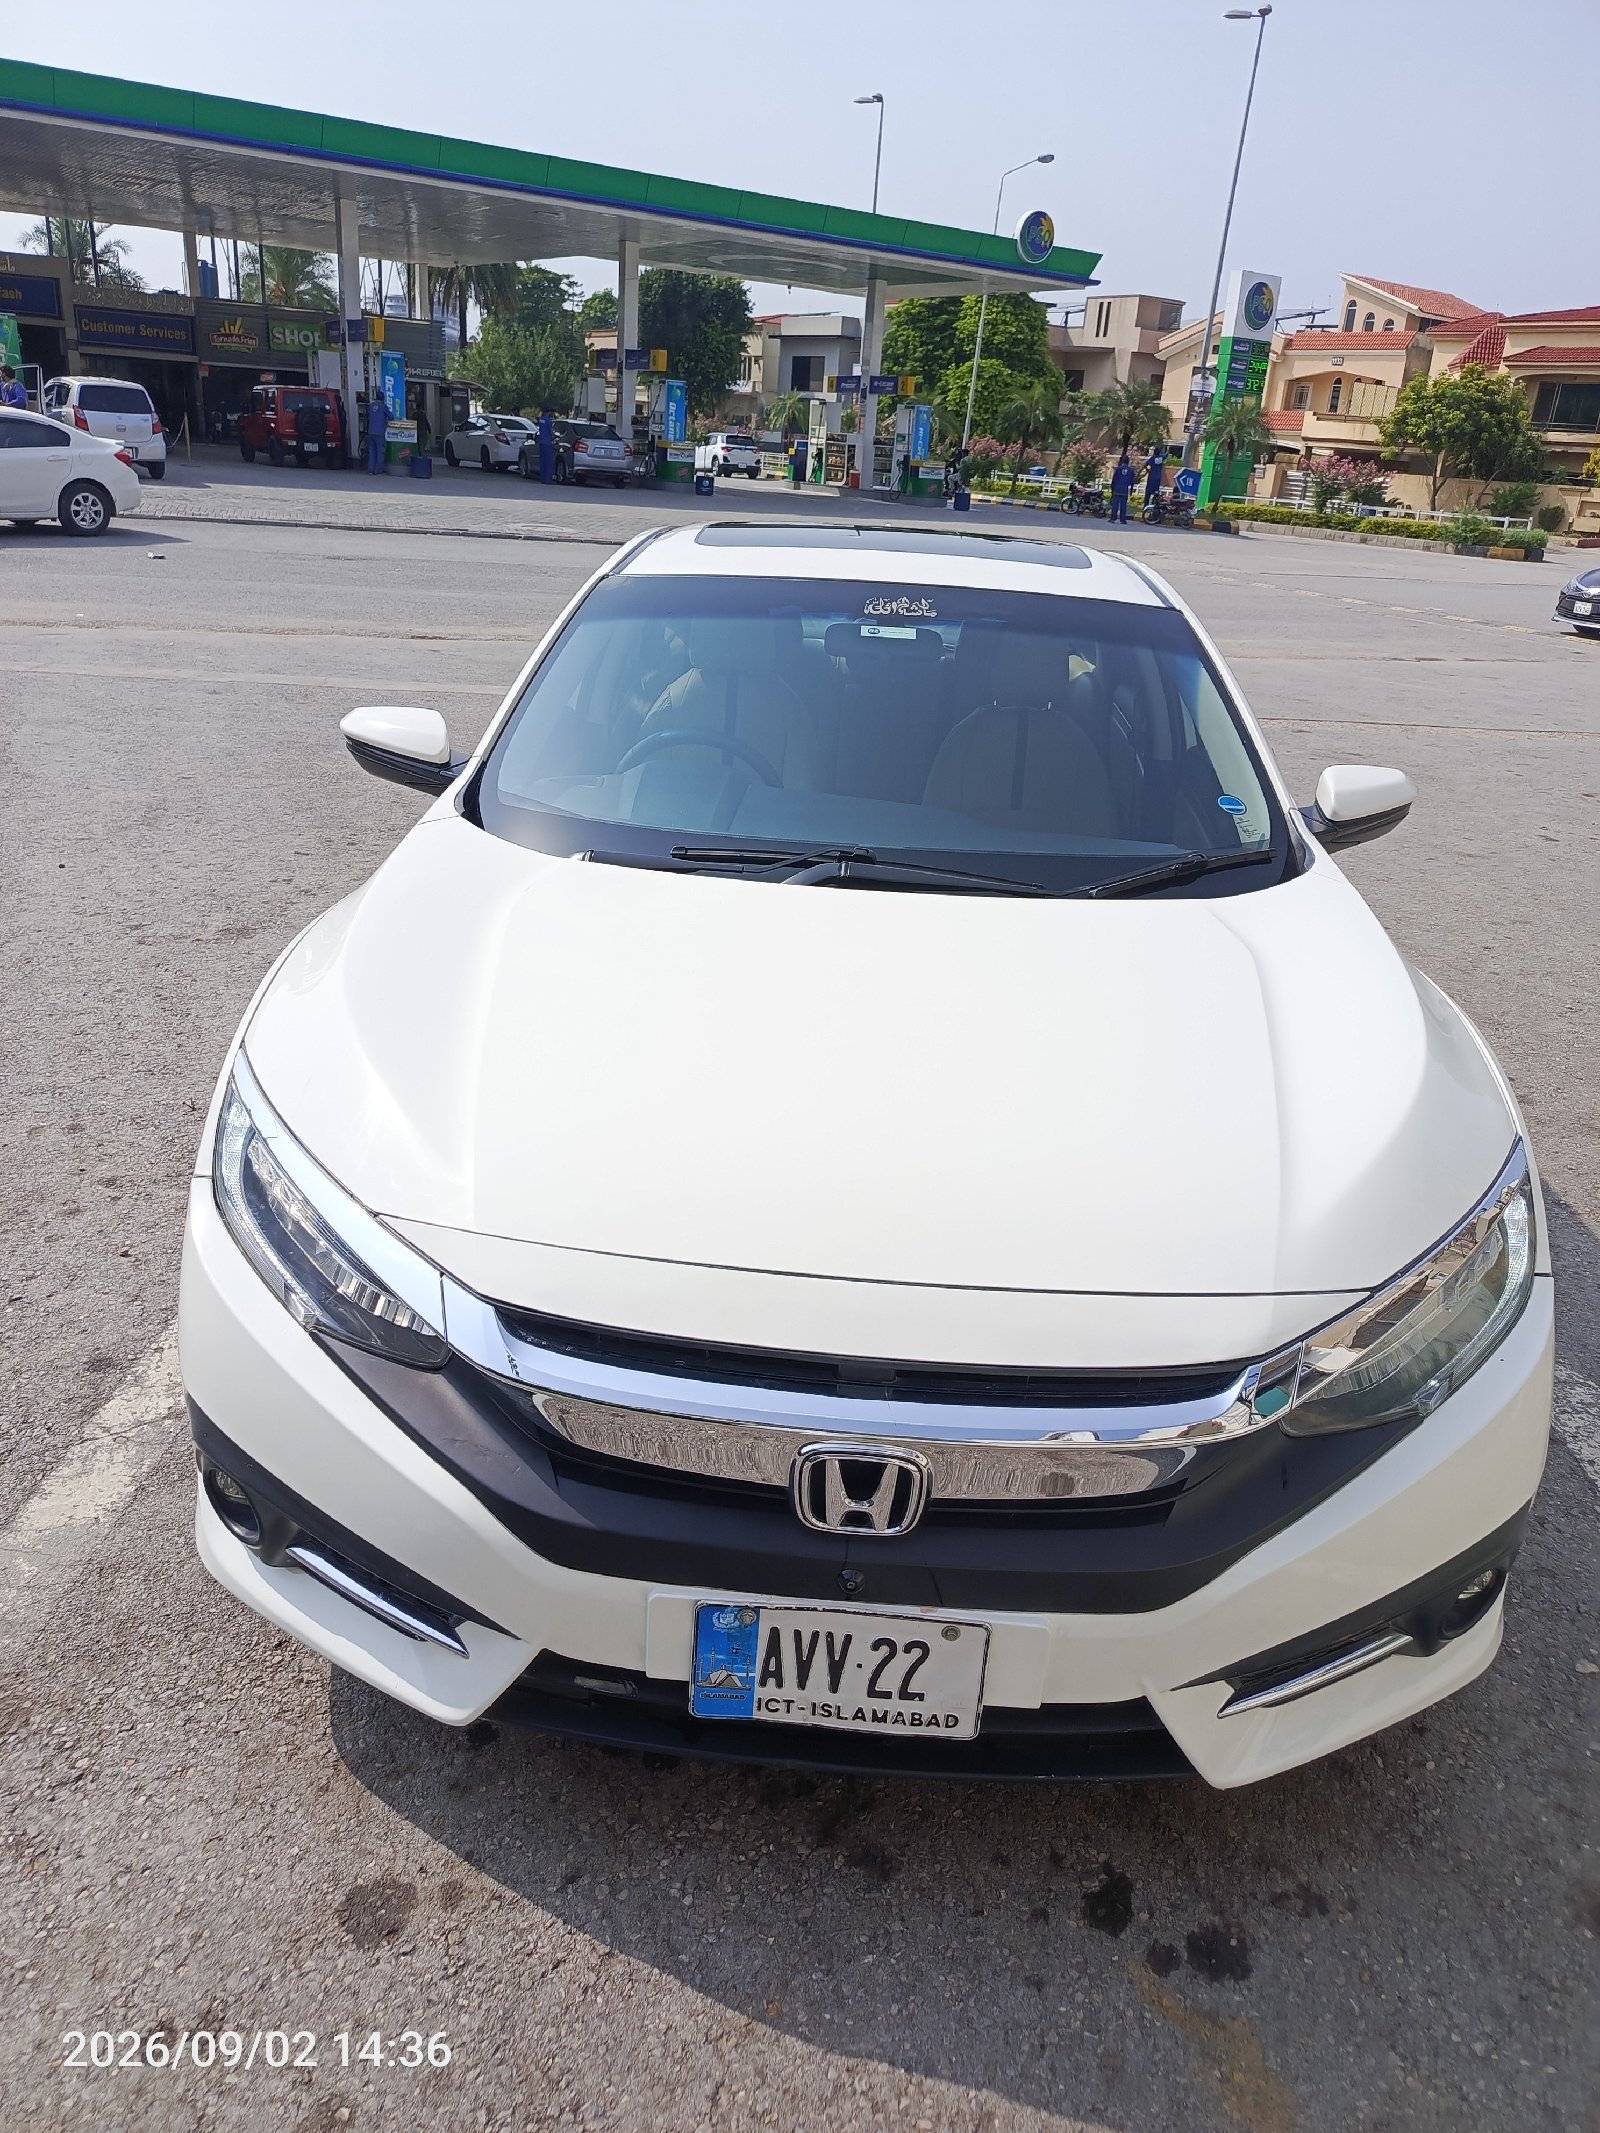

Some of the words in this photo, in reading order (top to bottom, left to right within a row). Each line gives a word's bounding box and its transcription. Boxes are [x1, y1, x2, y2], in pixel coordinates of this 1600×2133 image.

[1028, 225, 1051, 244] PSO
[0, 288, 22, 300] ash
[1252, 295, 1273, 314] PSO
[81, 318, 135, 335] Customer
[140, 323, 187, 341] Services
[755, 1696, 960, 1729] ICT-ISLAMABAD
